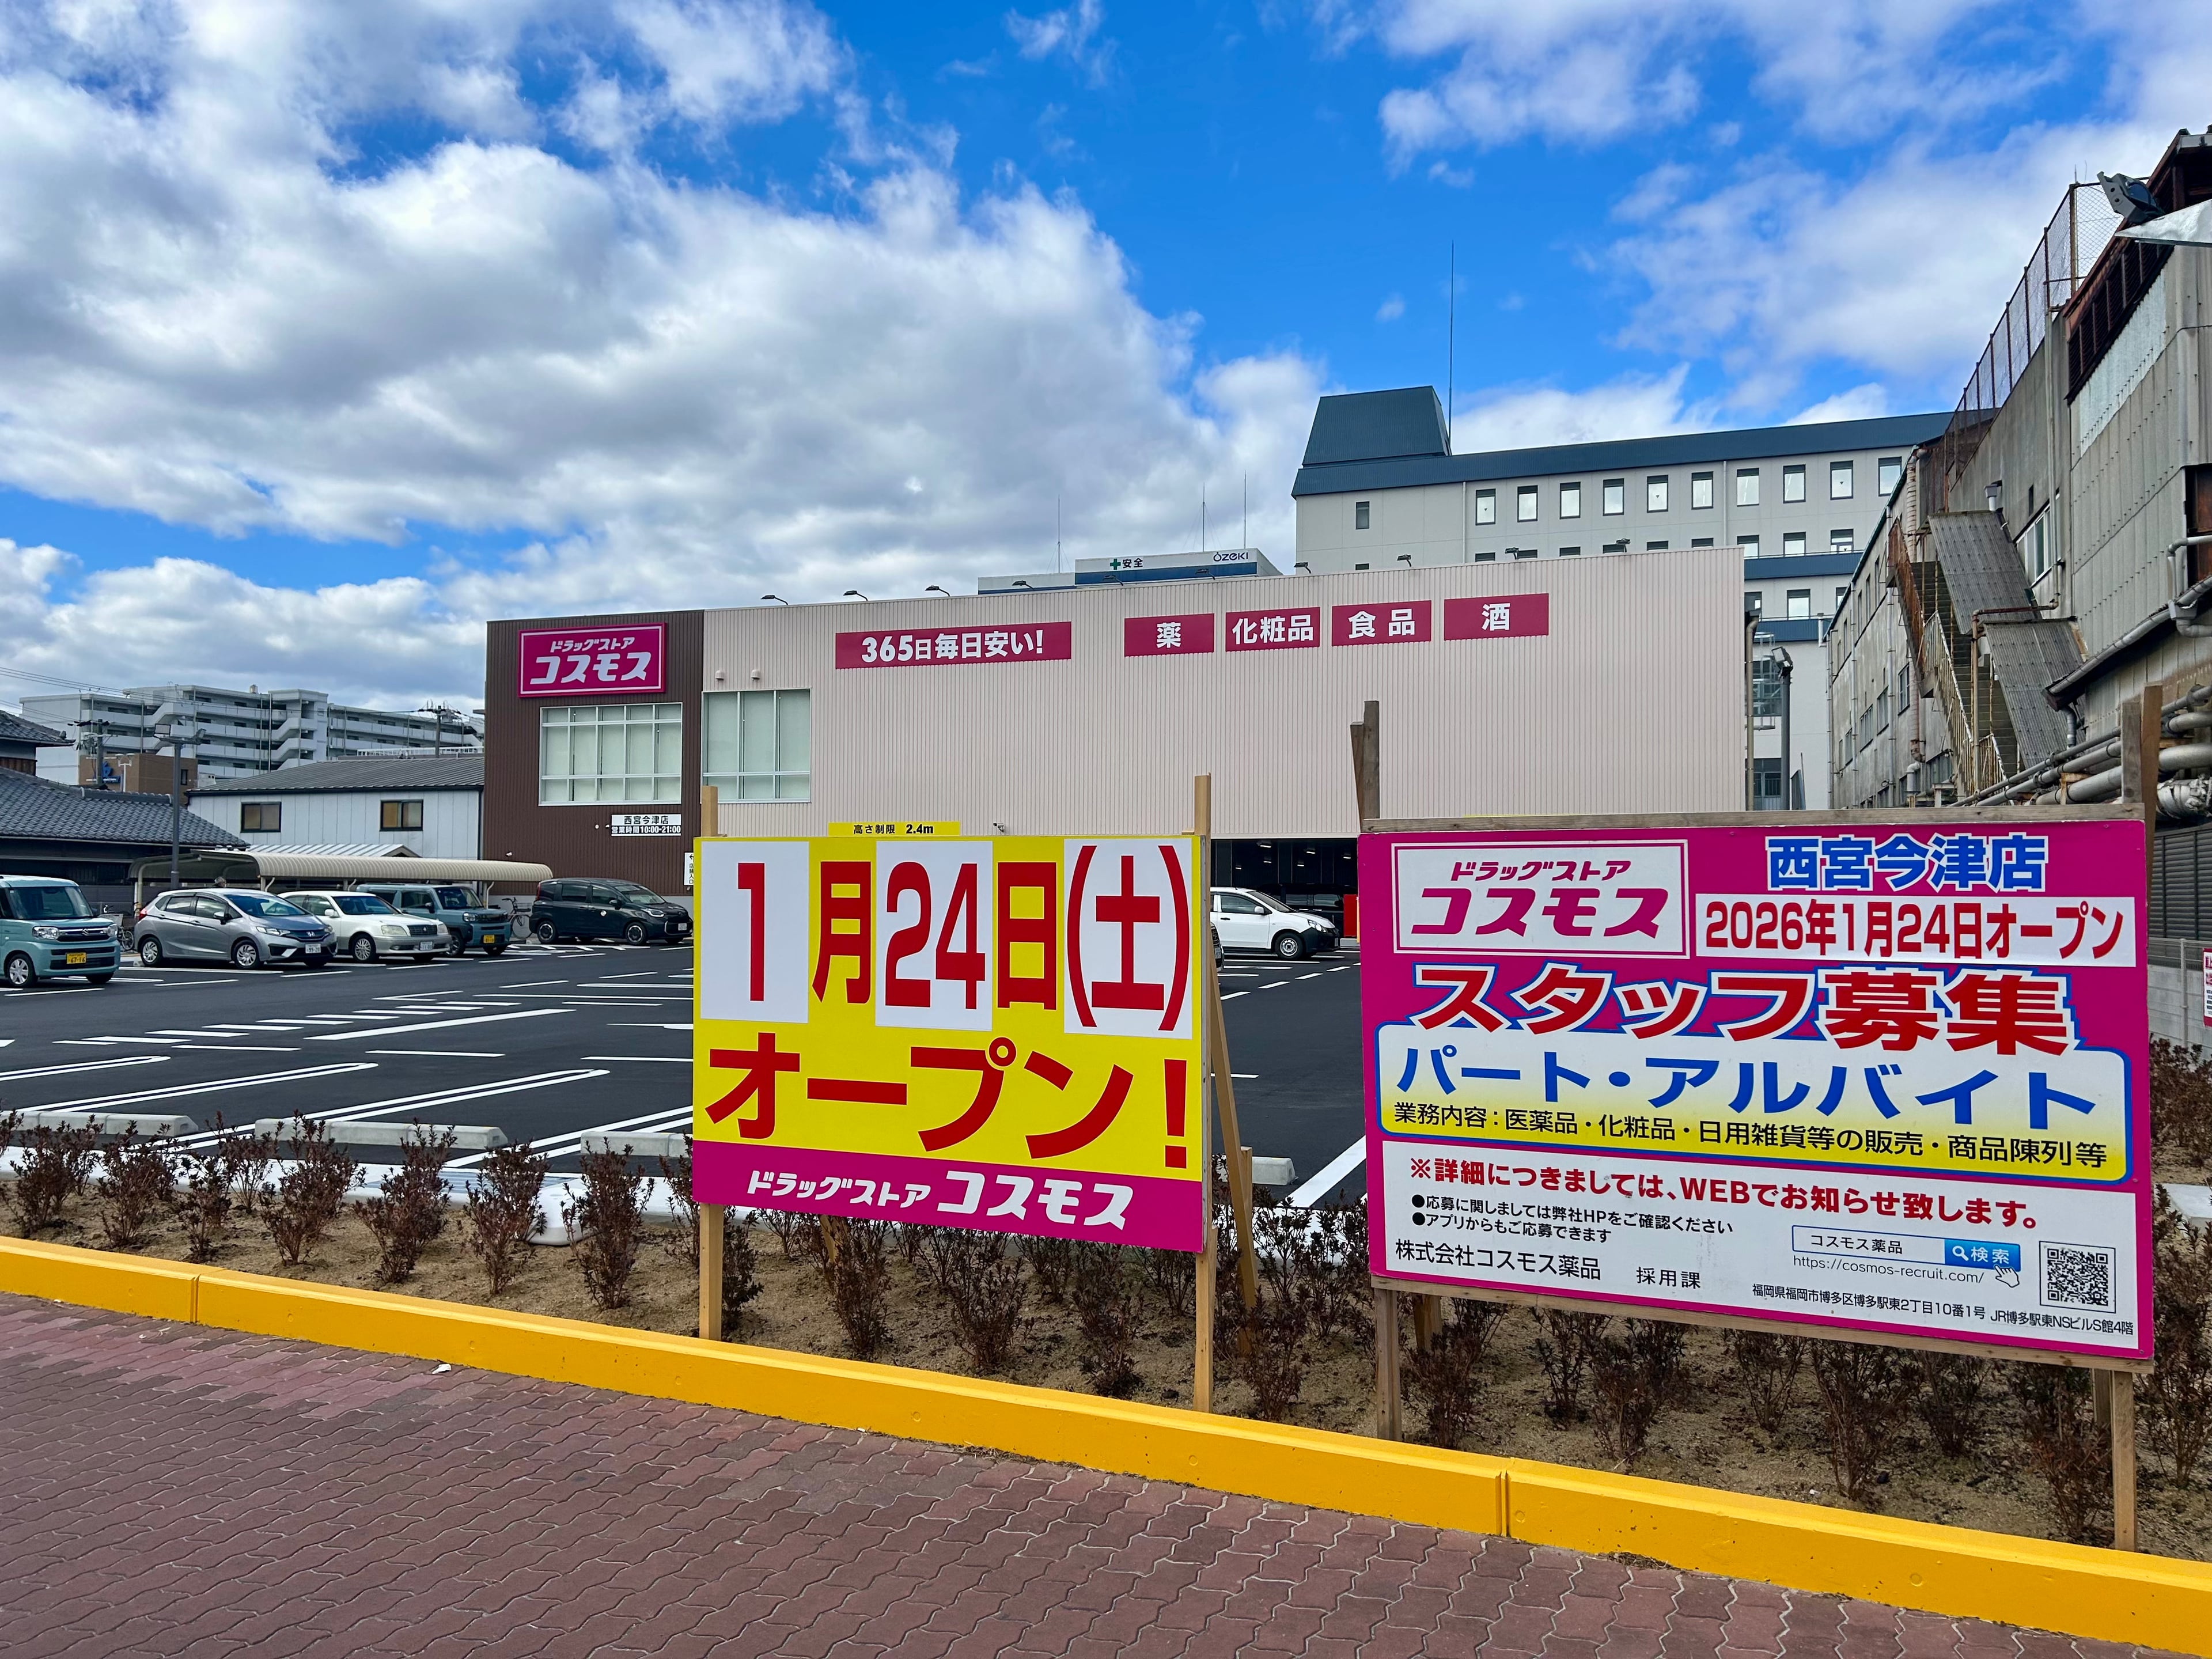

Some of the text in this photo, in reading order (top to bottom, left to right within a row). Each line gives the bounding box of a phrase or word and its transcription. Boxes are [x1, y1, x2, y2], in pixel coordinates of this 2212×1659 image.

[1122, 558, 1143, 569] 安全
[1231, 613, 1314, 645] 化粧品
[1481, 601, 1512, 631] 酒
[550, 637, 635, 653] ドラッグストア
[1156, 622, 1183, 649] 薬
[529, 651, 652, 685] コスモス
[624, 815, 669, 825] 西宮今津店
[853, 824, 934, 835] 高さ制限 2.4m
[1450, 861, 1632, 882] ドラッグストア
[1765, 832, 2048, 892] 西宮今津店
[1411, 887, 1669, 940] コスモス
[1705, 898, 2124, 960] 2026年1月24日オープン
[1414, 965, 2071, 1057] スタッフ募集
[1396, 1044, 2096, 1130] パート・アルバイト
[747, 1169, 1134, 1232] ドラッグストア コスモス
[1809, 1233, 1903, 1255] コスモス薬品
[1969, 1246, 2010, 1266] 検索
[1395, 1238, 1701, 1290] 株式会社コスモス薬品 採用課
[1793, 1255, 1985, 1285] https://cosmos-recruit.com/
[1752, 1283, 1986, 1321] 福岡県福岡市博多区博多駅東2丁目10番1号
